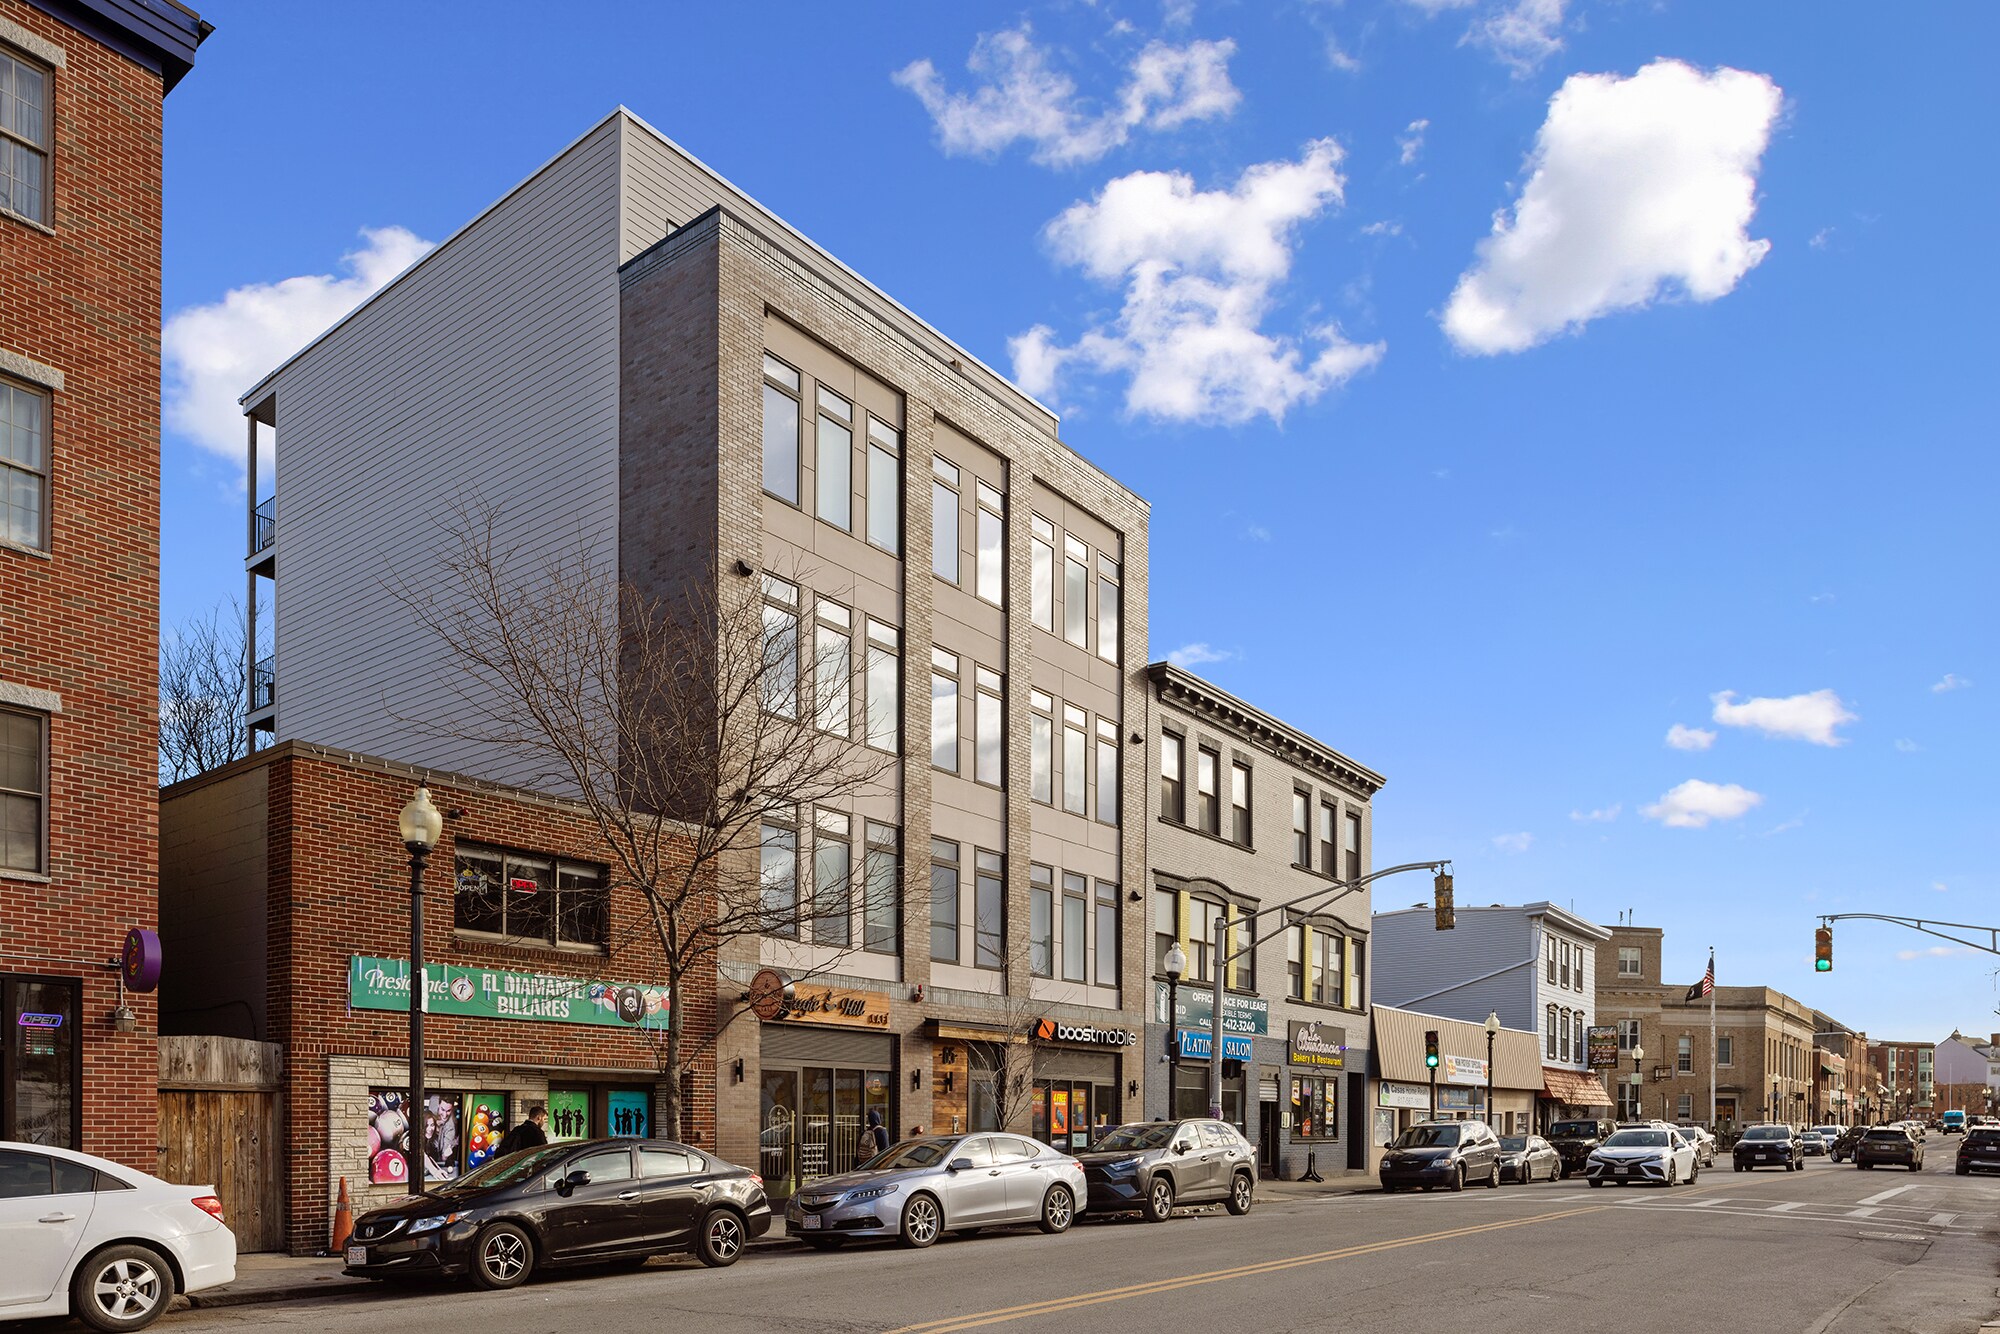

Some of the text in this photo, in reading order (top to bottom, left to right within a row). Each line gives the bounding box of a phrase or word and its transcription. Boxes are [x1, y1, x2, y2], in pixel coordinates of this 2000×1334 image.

[365, 969, 449, 994] Presinte
[482, 973, 585, 1000] EL DIAMANTE
[368, 989, 411, 998] IMPORT
[497, 996, 570, 1018] BILLARES
[1175, 1004, 1187, 1015] RID
[1237, 999, 1249, 1009] FOR
[1249, 1000, 1267, 1012] LEASE
[22, 1015, 60, 1025] OPEN
[1237, 1011, 1252, 1020] TERMS
[1199, 1018, 1212, 1026] CALL
[1181, 1031, 1251, 1057] PLATIN SALON
[1293, 1052, 1310, 1064] Bakery
[1317, 1055, 1342, 1066] Restaurant
[1391, 1085, 1405, 1094] Casas
